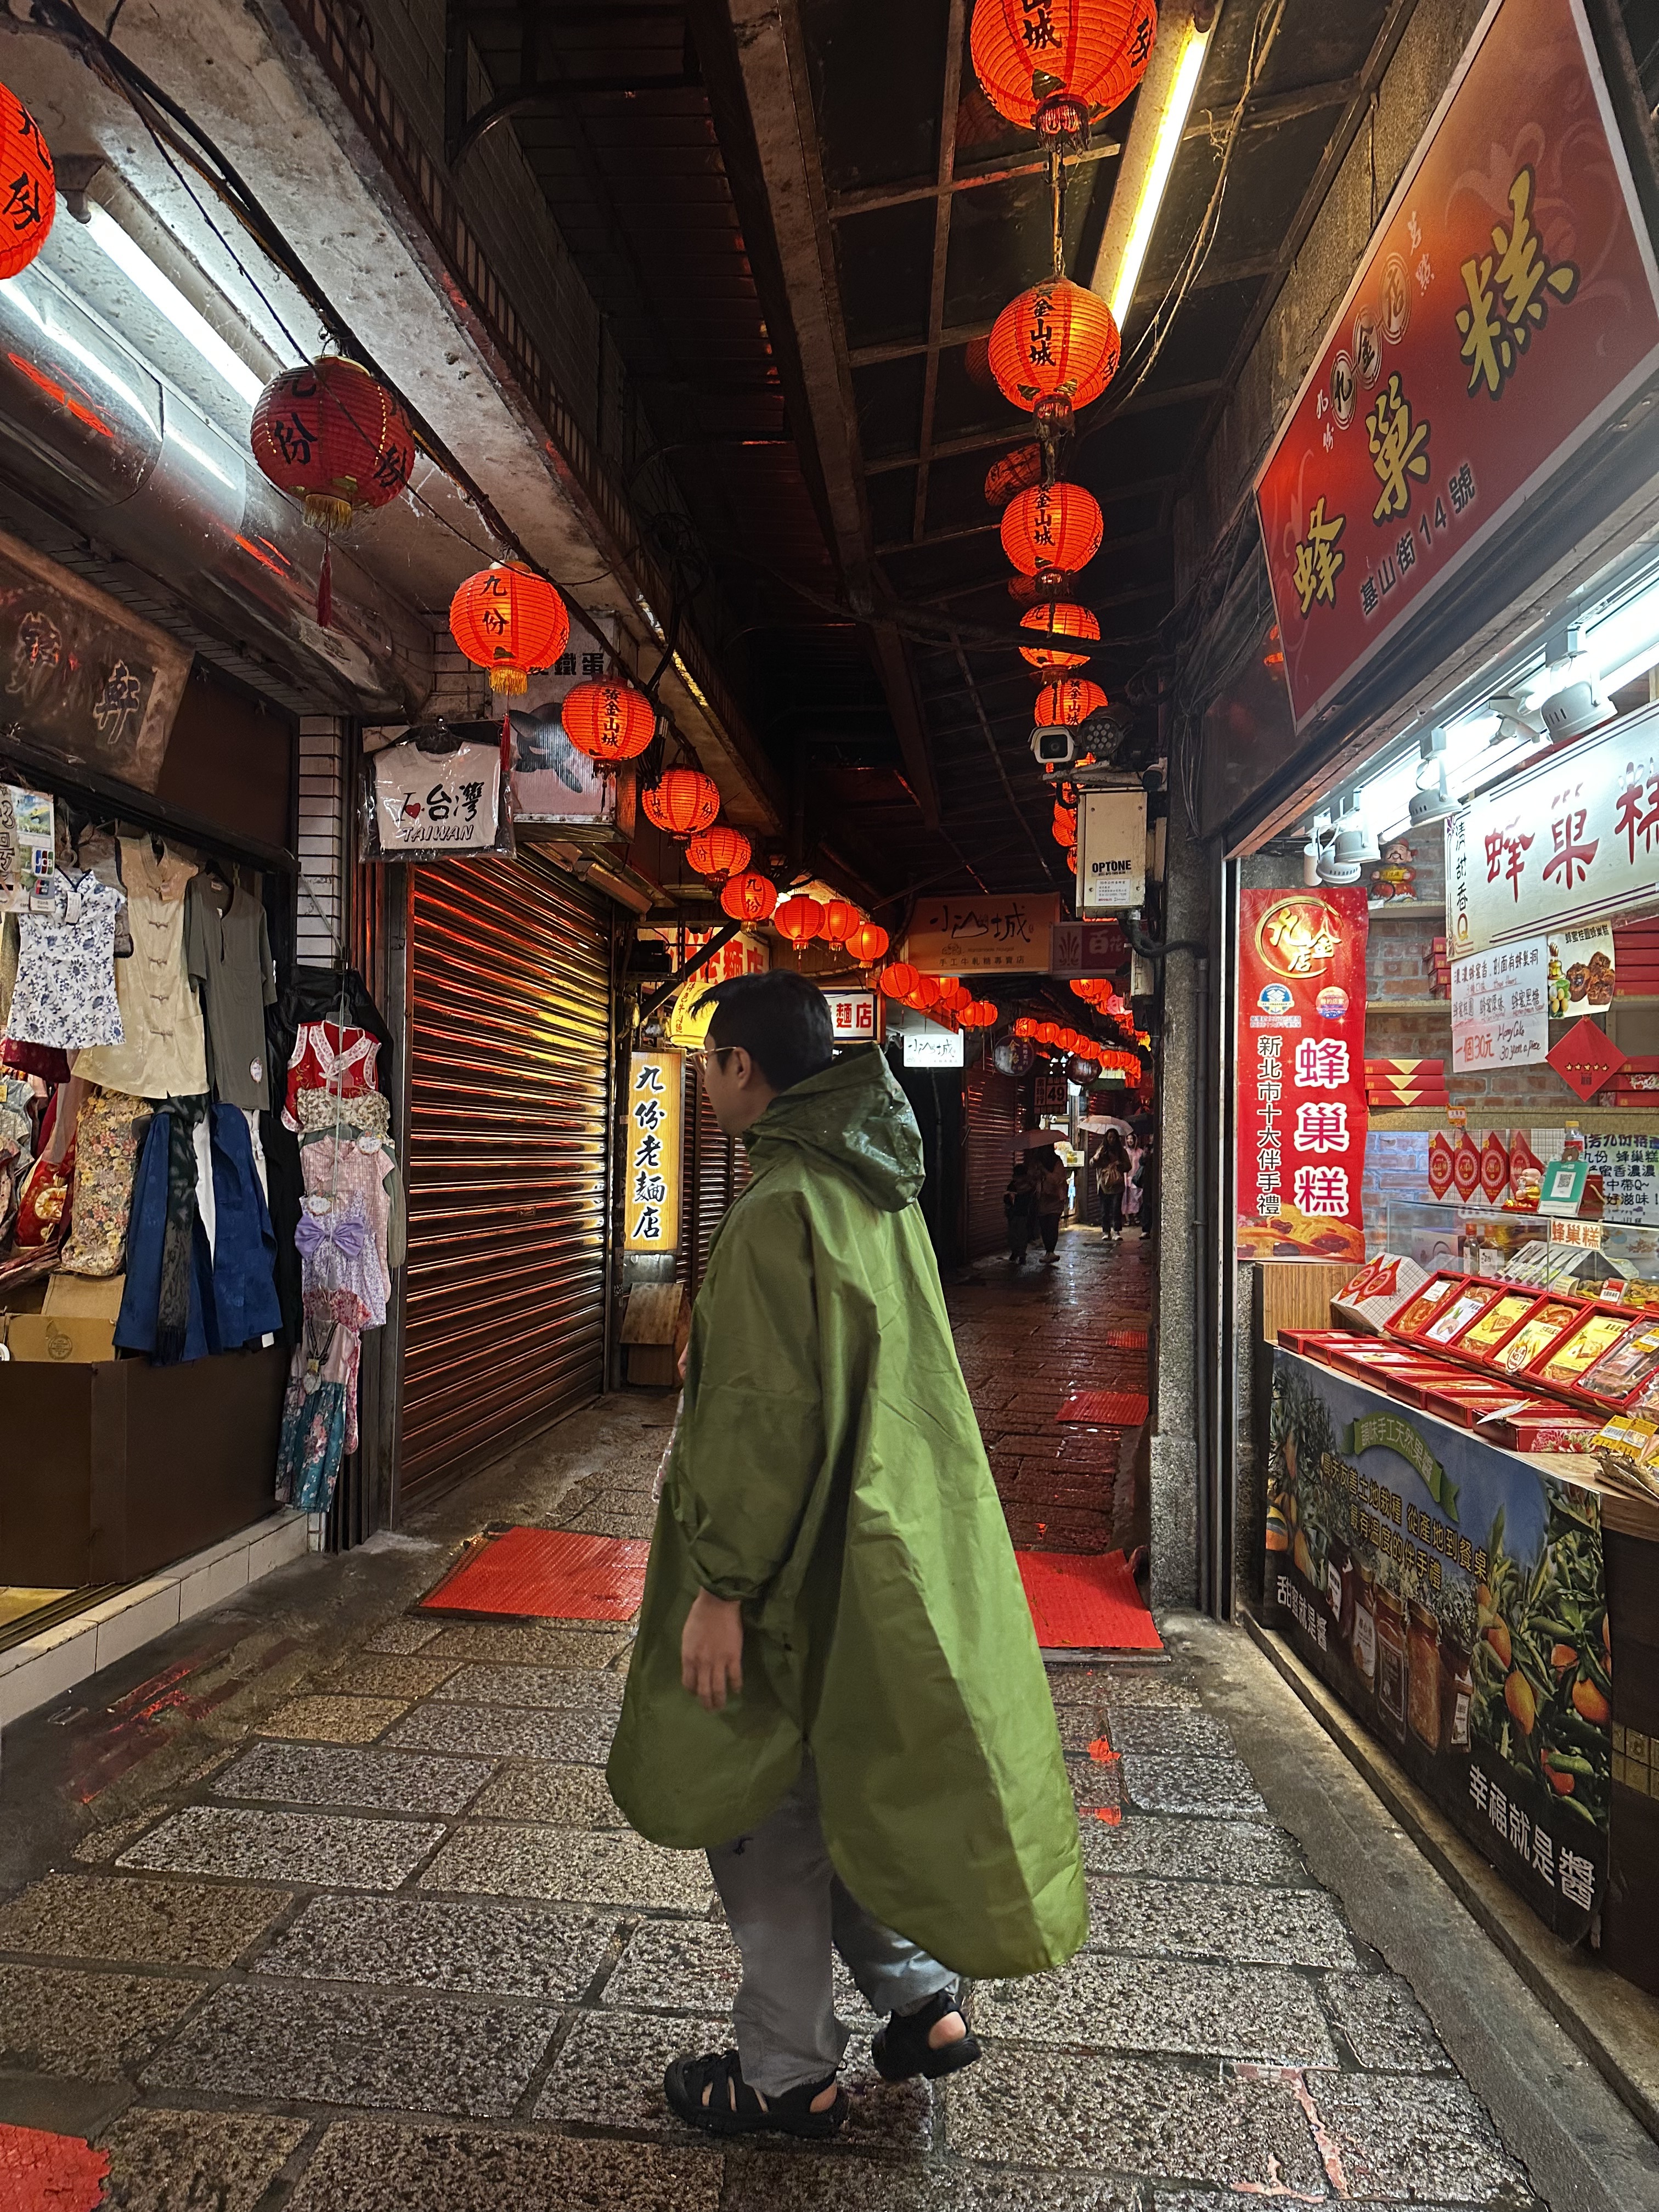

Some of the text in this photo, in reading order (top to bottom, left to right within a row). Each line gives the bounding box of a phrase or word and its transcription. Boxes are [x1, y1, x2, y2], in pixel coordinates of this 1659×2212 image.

[1294, 166, 1576, 614] 蜂巢糕
[1361, 464, 1476, 616] 基山街14號
[483, 575, 509, 636] 九份
[531, 653, 603, 675] 鐵蛋
[601, 689, 623, 748] 黃金山城
[426, 781, 484, 822] 台灣
[403, 825, 474, 842] TAIWAN
[36, 857, 53, 867] JCB
[1092, 860, 1132, 873] OPTONE
[746, 878, 763, 913] 九份
[1089, 929, 1128, 954] 百花
[829, 1002, 872, 1028] 麵店
[1455, 1032, 1494, 1063] 一個30元
[1047, 1086, 1065, 1101] 49
[1257, 1035, 1283, 1217] 新北市十大伴手禮
[1294, 1037, 1350, 1217] 蜂巢糕
[633, 1066, 665, 1238] 九份老麵店
[1603, 1178, 1649, 1192] 中帶Q~
[1603, 1193, 1658, 1206] 好滋味！
[1552, 1222, 1600, 1249] 蜂巢糕
[1350, 1504, 1442, 1590] 最有溫度的伴手禮
[1407, 1503, 1487, 1582] 從產地到餐桌
[1470, 1764, 1595, 1911] 幸福就是醬
